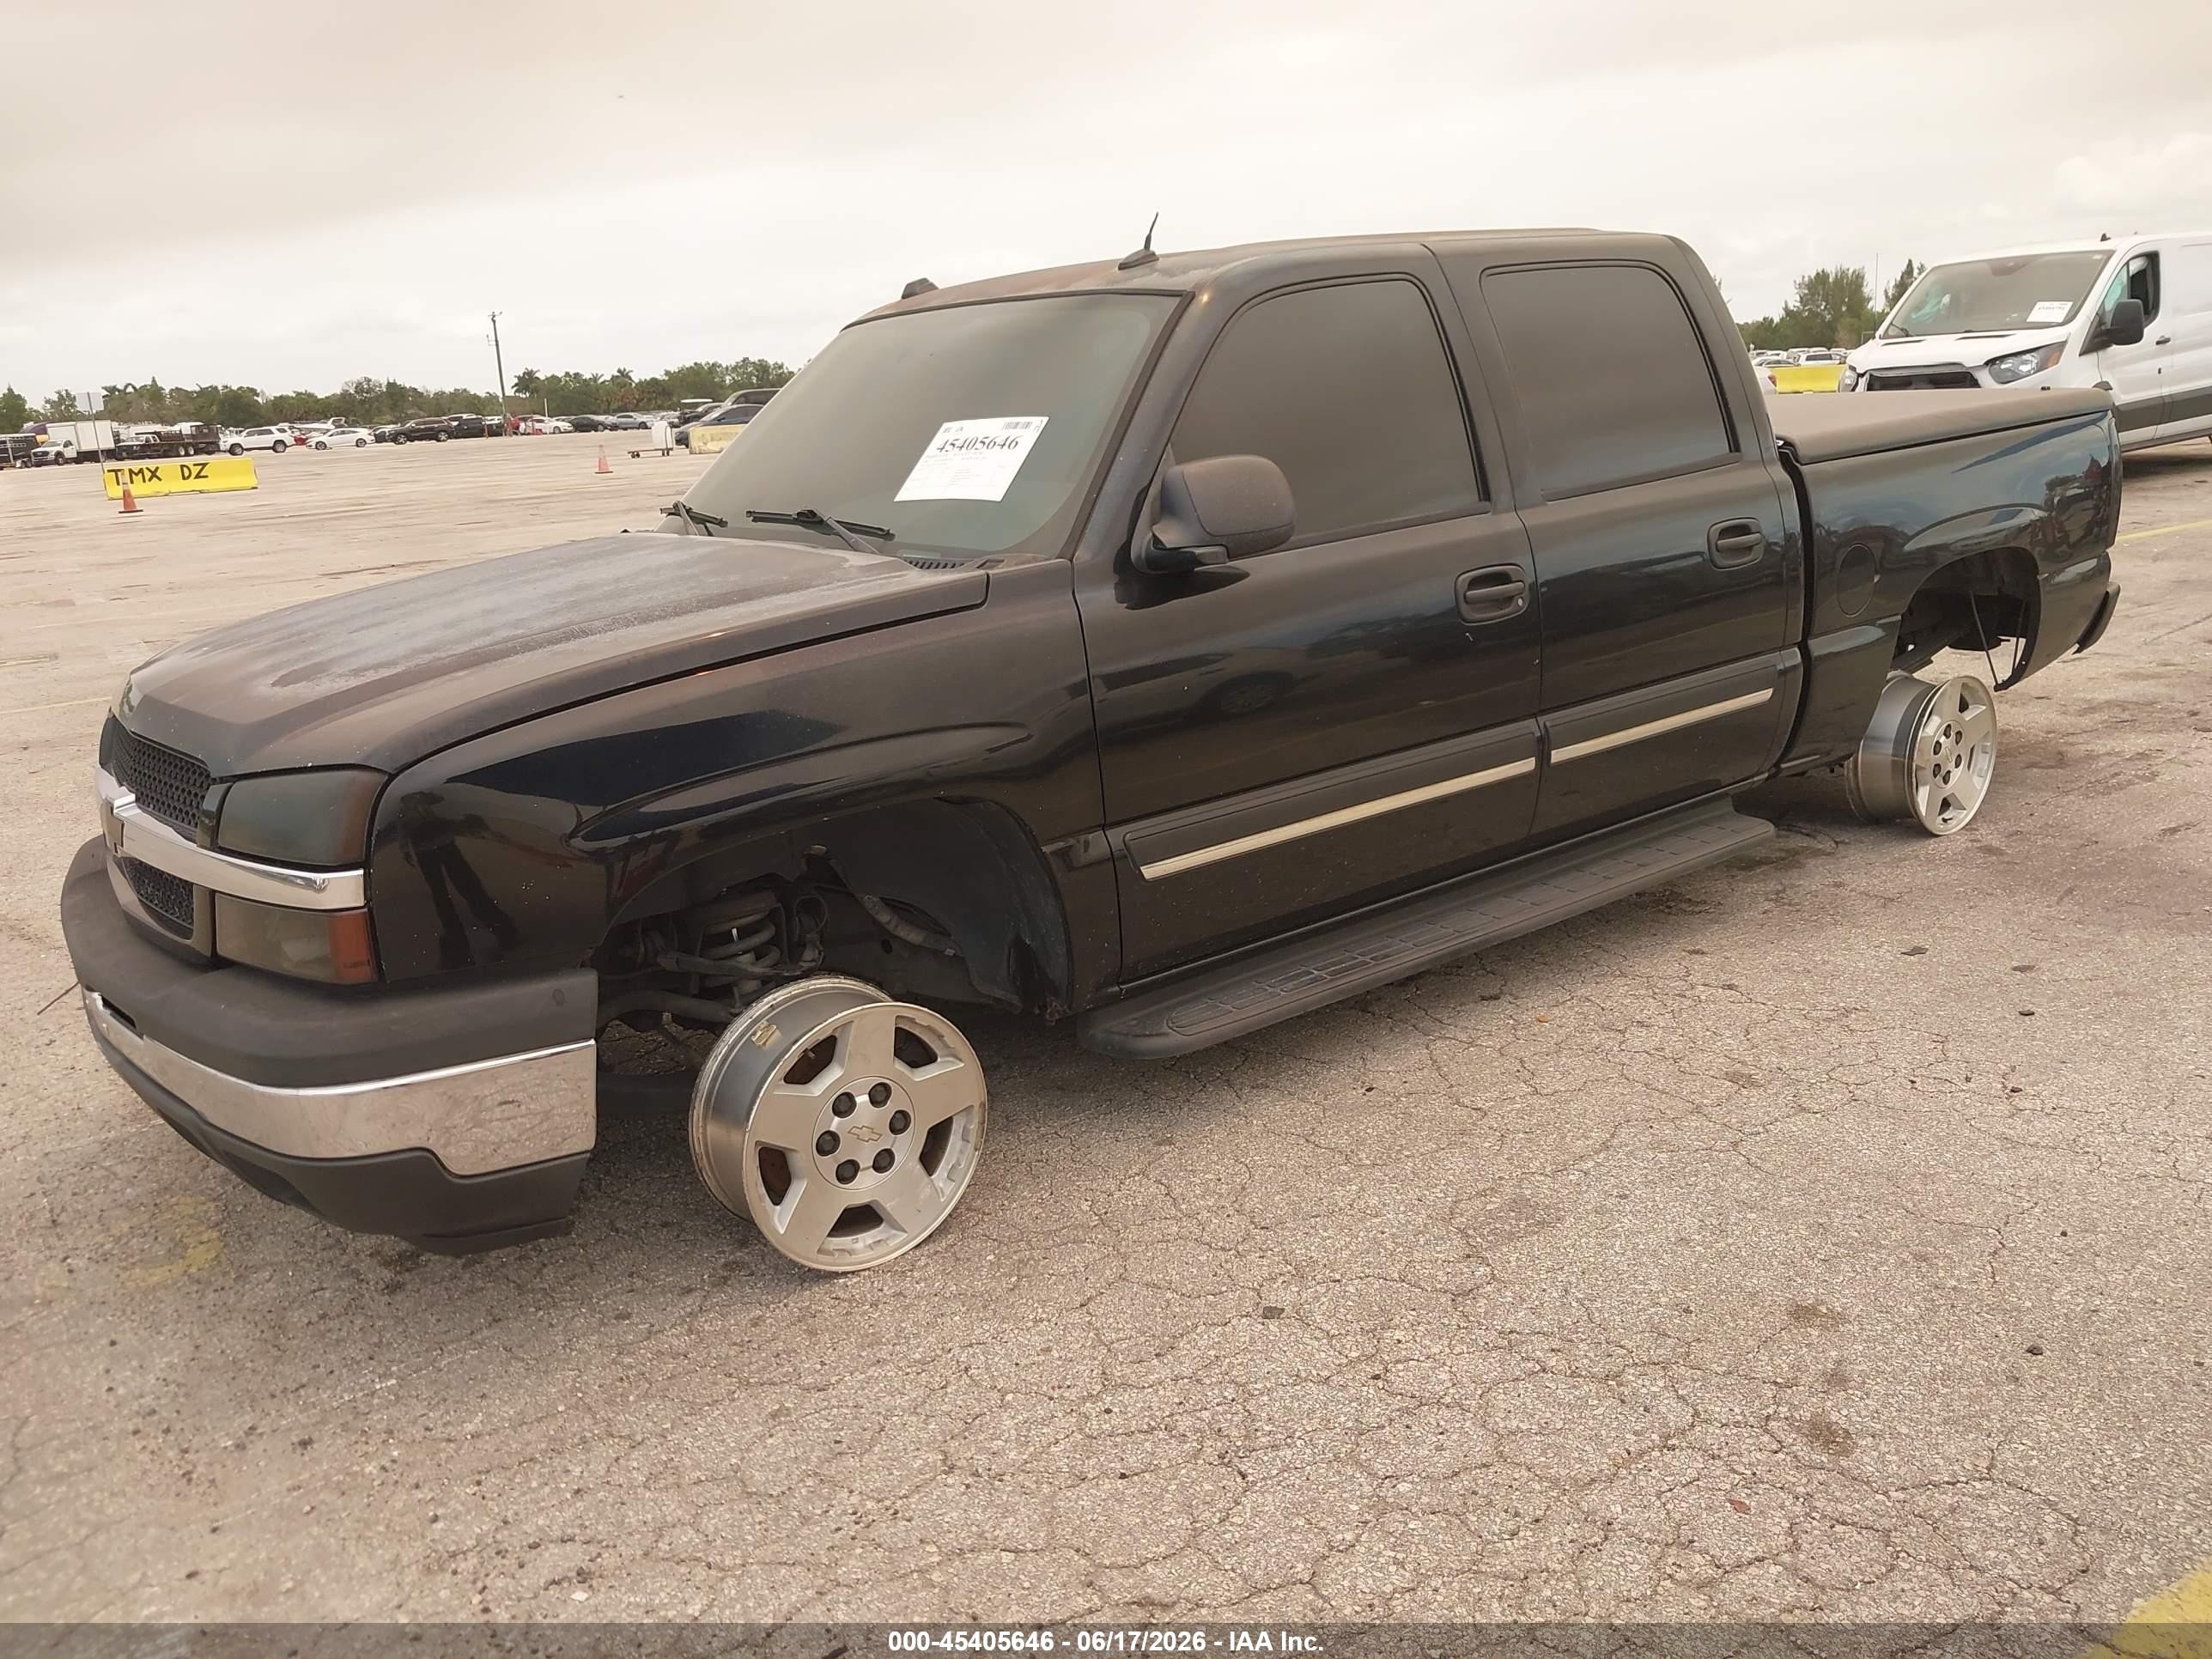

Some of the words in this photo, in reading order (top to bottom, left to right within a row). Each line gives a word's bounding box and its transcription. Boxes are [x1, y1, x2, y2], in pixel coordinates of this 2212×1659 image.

[937, 435, 1022, 453] 45405646
[107, 466, 162, 486] TMX
[179, 462, 210, 481] DZ
